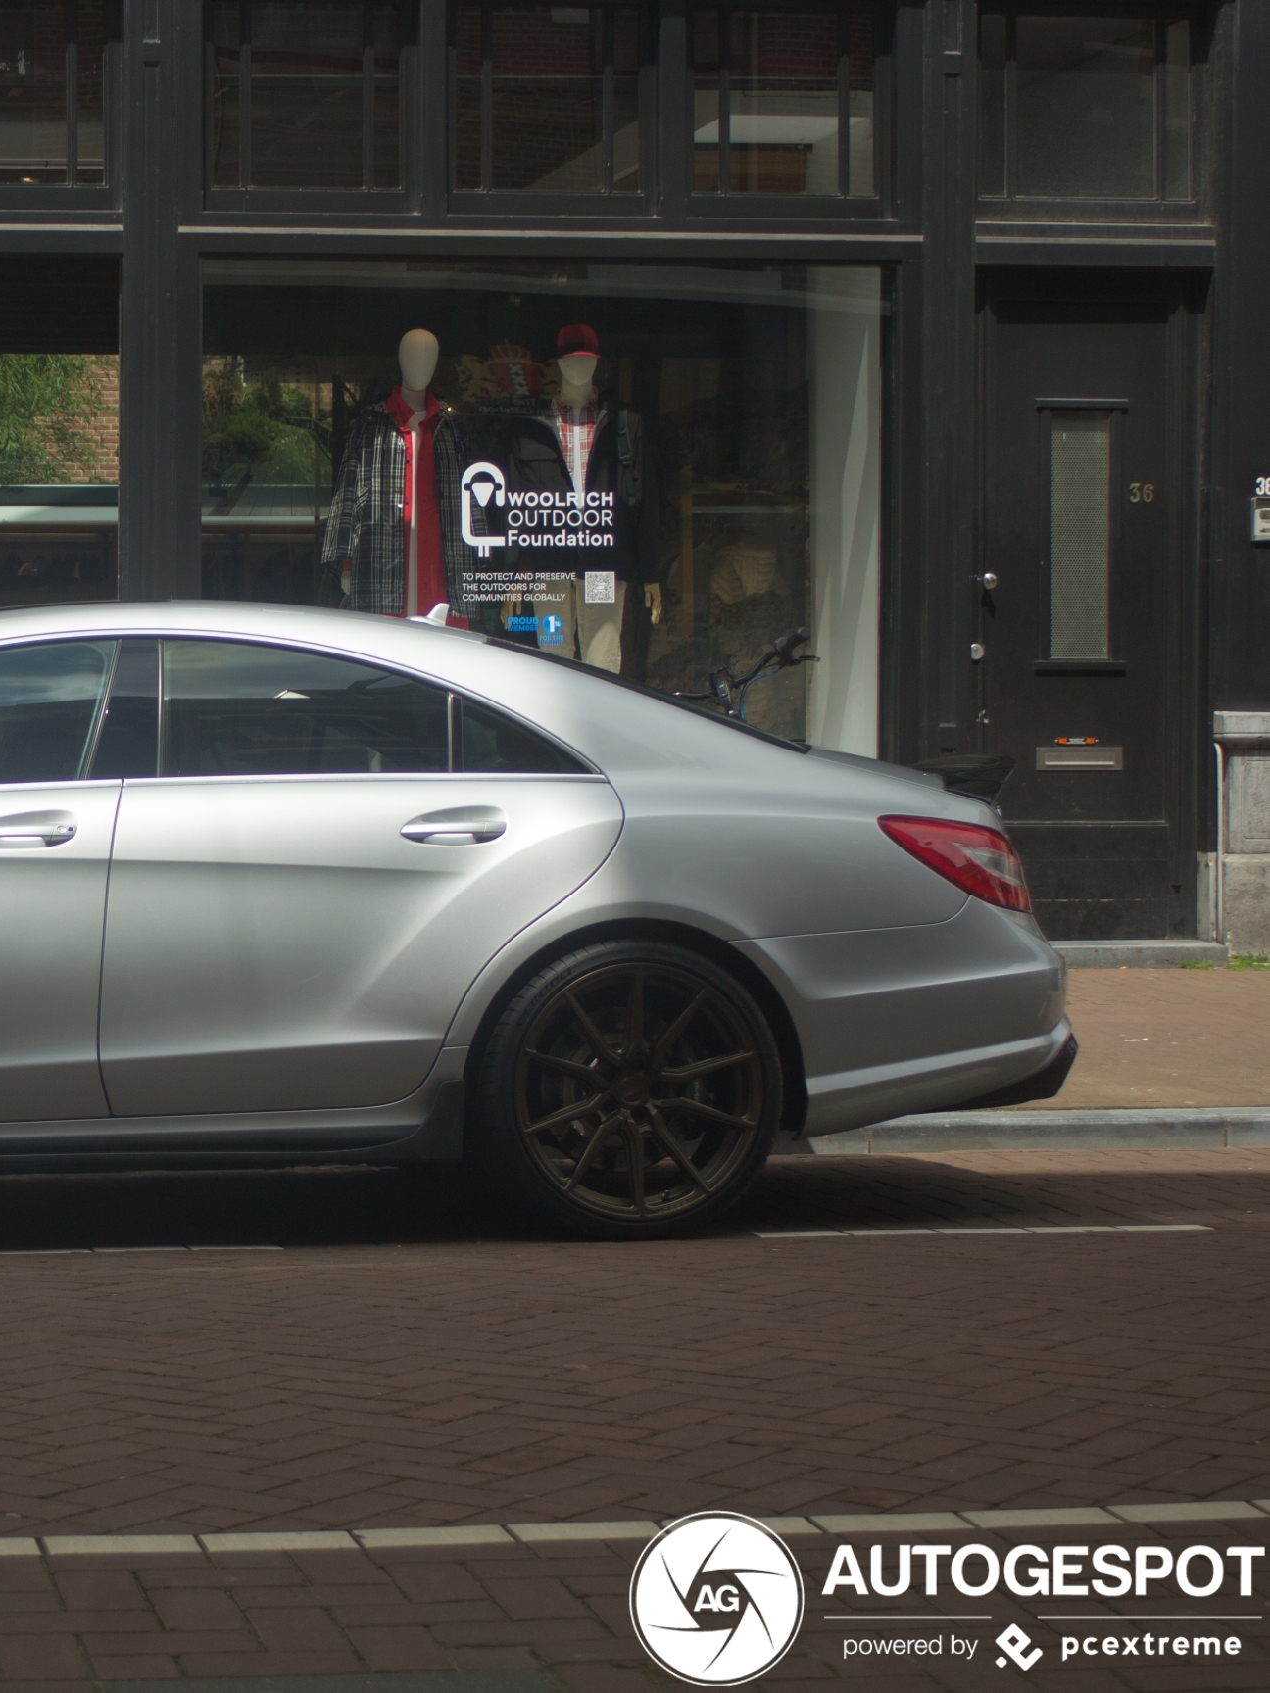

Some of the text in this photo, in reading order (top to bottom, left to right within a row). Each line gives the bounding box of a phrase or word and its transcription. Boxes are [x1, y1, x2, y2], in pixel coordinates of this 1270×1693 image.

[1130, 483, 1154, 502] 36
[508, 492, 613, 507] WOOLRICH
[508, 509, 613, 527] OUTDOOR
[508, 529, 613, 546] Foundation
[462, 572, 576, 581] TO PROTECT AND PRESERVE
[462, 583, 547, 591] THE OUTDOORS FOR
[462, 593, 566, 602] COMMUNITIES GLOBALLY
[507, 616, 539, 625] PROUD
